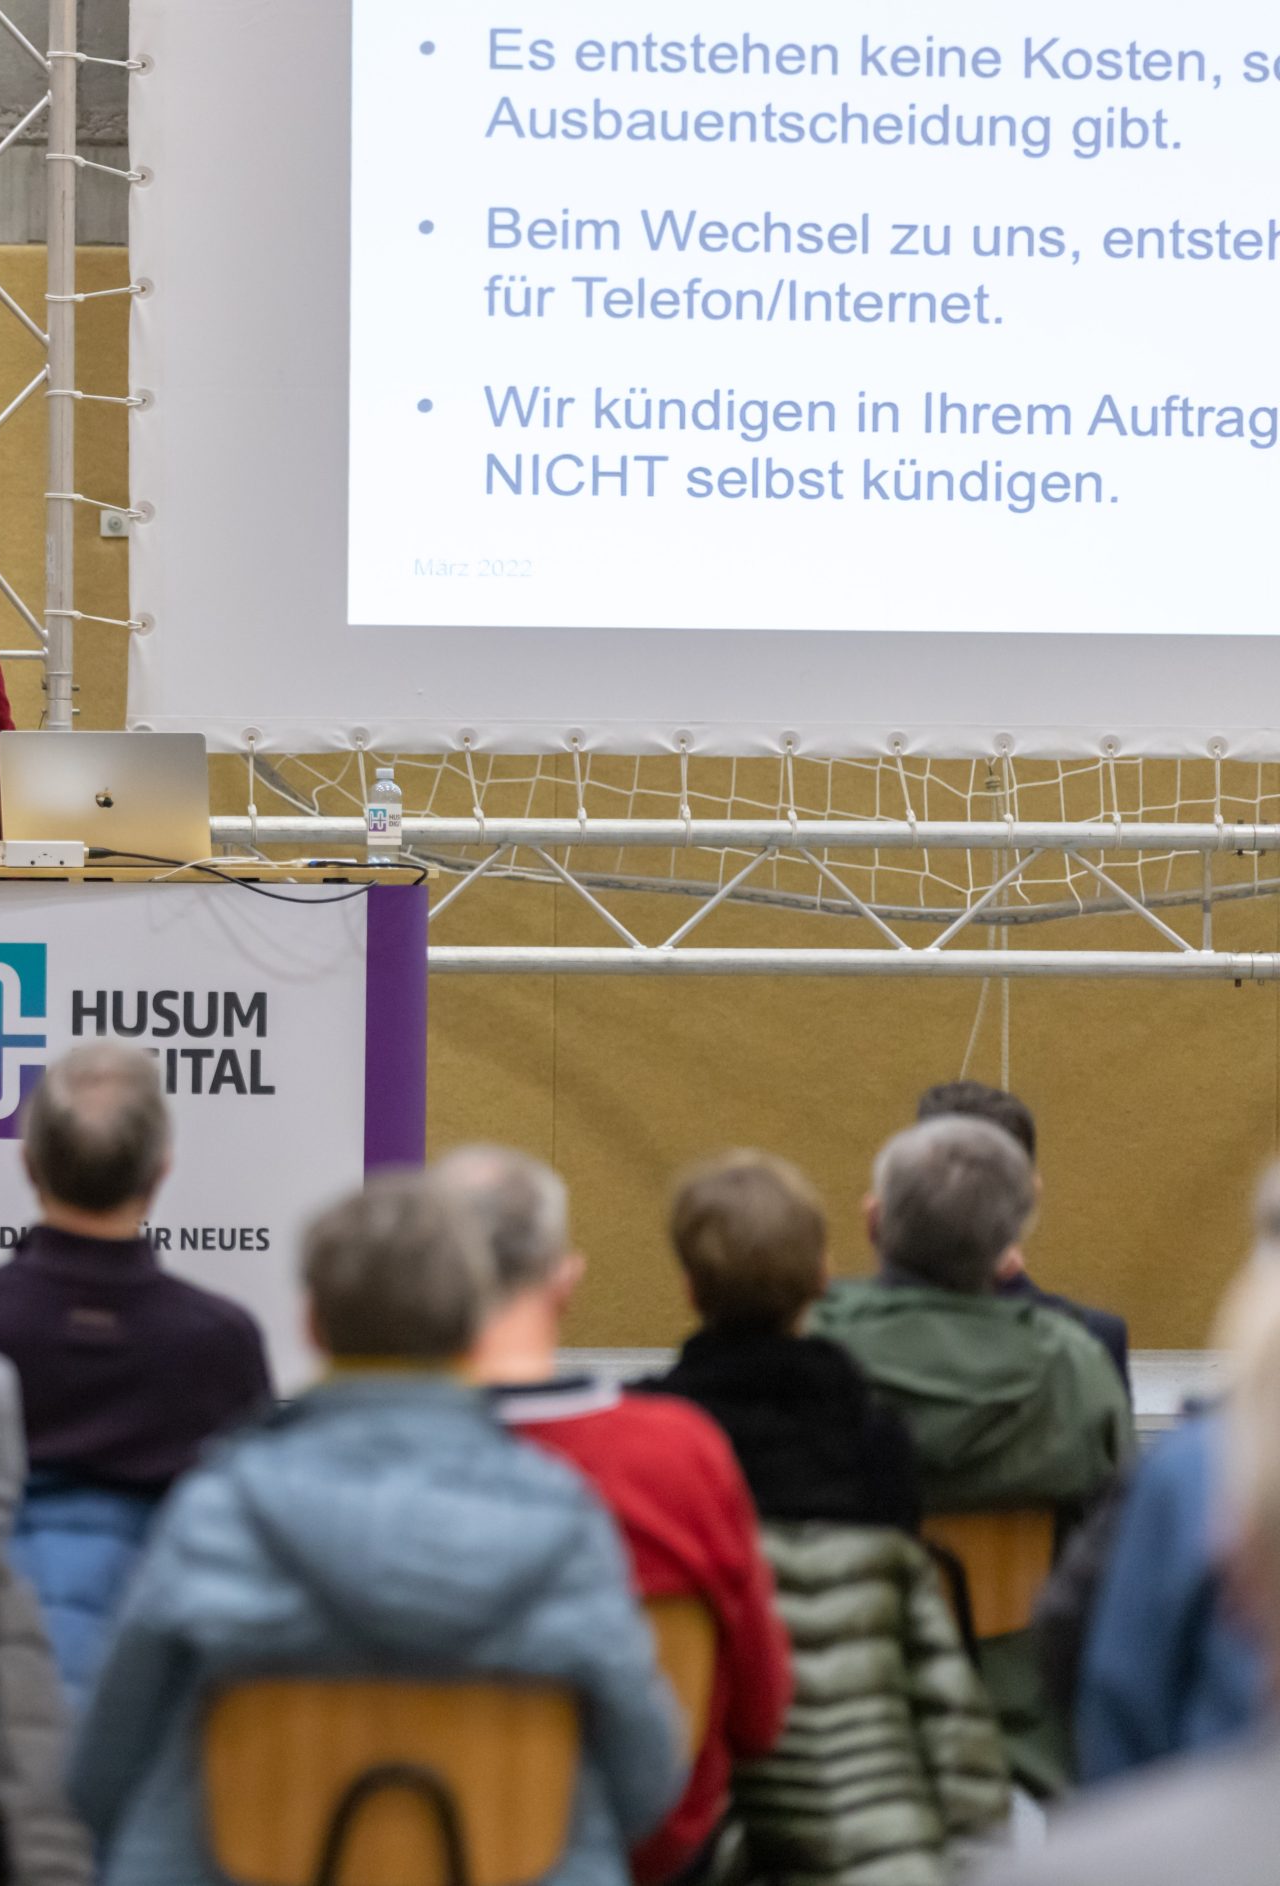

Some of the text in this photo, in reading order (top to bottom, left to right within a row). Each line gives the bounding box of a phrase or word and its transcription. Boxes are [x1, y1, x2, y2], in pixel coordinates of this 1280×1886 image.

[488, 28, 556, 72] Es
[575, 32, 839, 76] entstehen
[860, 35, 1002, 79] keine
[1024, 37, 1222, 89] Kosten,
[484, 97, 1181, 159] Ausbauentscheidung gibt.
[487, 206, 620, 251] Beim
[640, 210, 869, 255] Wechsel
[889, 223, 951, 256] zu
[973, 226, 1080, 265] uns,
[483, 275, 1003, 325] für Telefon/Internet.
[483, 386, 1279, 450] Wir kündigen in Ihrem Auftrag
[486, 454, 1118, 514] NICHT selbst kündigen.
[72, 989, 268, 1038] HUSUM
[148, 1048, 276, 1095] ITAL
[180, 1228, 271, 1251] NEUES
